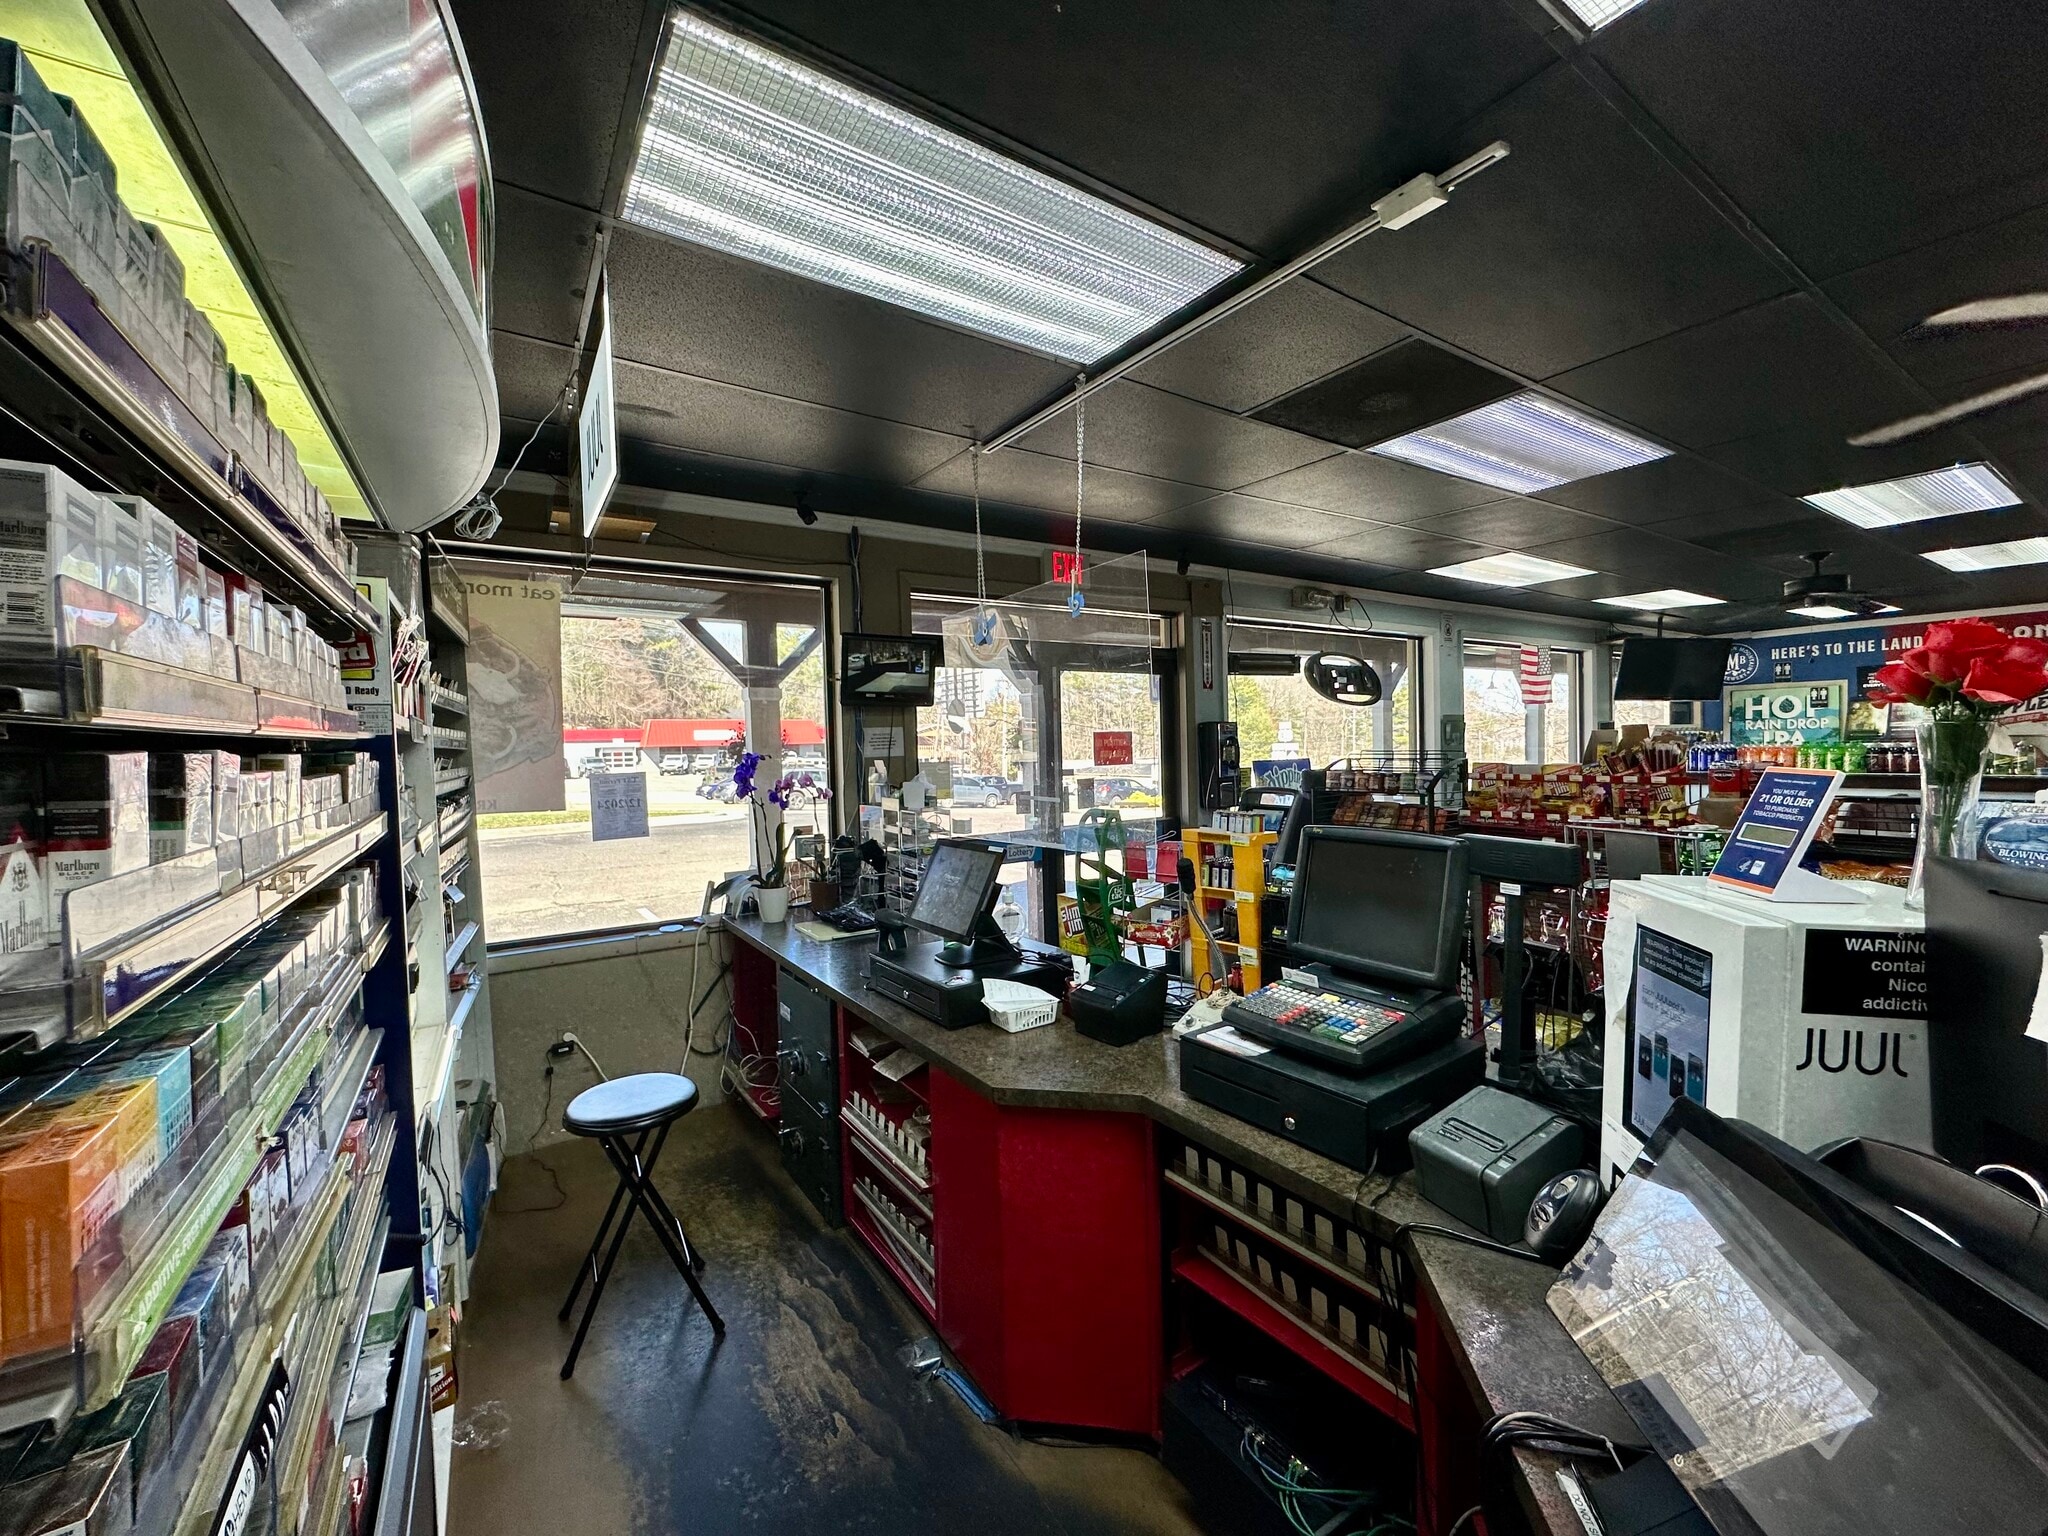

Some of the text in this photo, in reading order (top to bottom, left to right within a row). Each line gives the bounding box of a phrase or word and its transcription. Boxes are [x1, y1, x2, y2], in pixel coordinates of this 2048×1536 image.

[1053, 551, 1084, 584] EXIT
[1771, 635, 1923, 660] HERE'S TO THE LAND
[355, 686, 380, 696] Ready
[1745, 717, 1830, 731] RAIN DROP
[1763, 729, 1806, 746] IPA
[1759, 794, 1815, 808] 21 OR OLDER
[1753, 809, 1805, 822] TOBACCO PRODUCTS
[1771, 805, 1800, 814] PURCHASE
[1008, 846, 1034, 858] Lottery
[1998, 848, 2048, 861] BLOWING
[55, 859, 100, 872] Marlboro
[1871, 961, 1926, 973] contai
[1796, 1028, 1908, 1078] JUUL
[1572, 1493, 1584, 1508] DO
[1579, 1507, 1595, 1527] NOT
